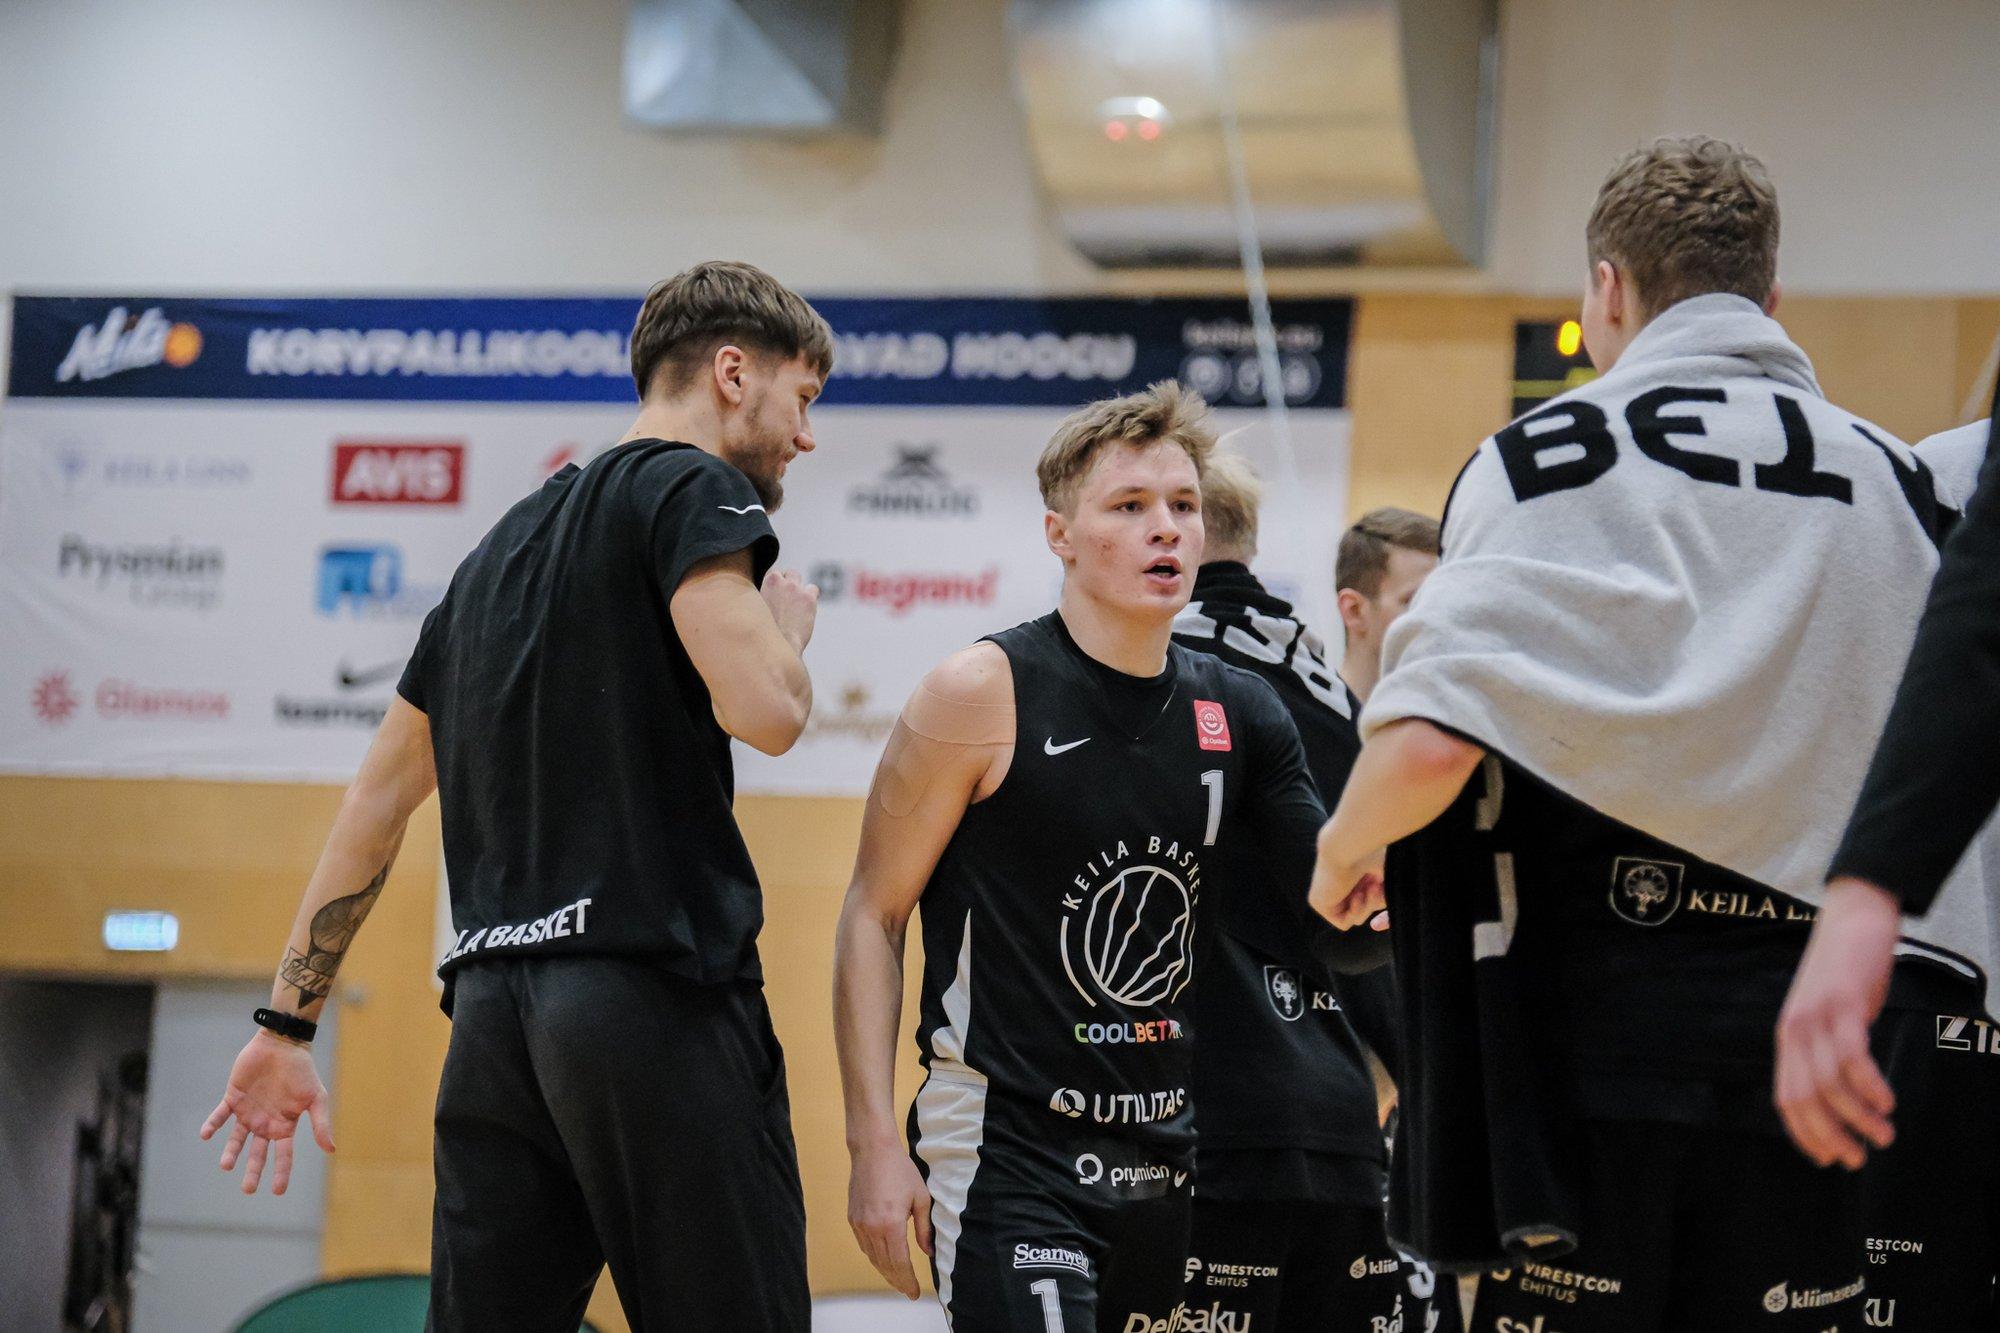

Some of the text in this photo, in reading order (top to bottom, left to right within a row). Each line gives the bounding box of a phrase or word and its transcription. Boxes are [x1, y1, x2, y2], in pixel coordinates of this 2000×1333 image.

[247, 328, 633, 377] KORVPALLIKOOL
[343, 449, 453, 499] AVIS
[57, 533, 224, 590] Prysmian
[857, 570, 997, 614] legrand
[96, 676, 231, 721] Glamox
[1201, 769, 1224, 846] 1
[1062, 840, 1130, 911] KEILA
[485, 898, 592, 948] BASKET
[1688, 889, 1778, 919] KEILA
[1074, 1020, 1167, 1044] COOLBET
[1208, 1262, 1279, 1277] VIRESTCON
[1523, 1261, 1622, 1294] VIRESTCON
[1867, 1252, 1887, 1265] US
[1205, 1275, 1259, 1288] EHITUS
[1519, 1277, 1578, 1304] EHITUS
[1030, 1279, 1066, 1333] 1
